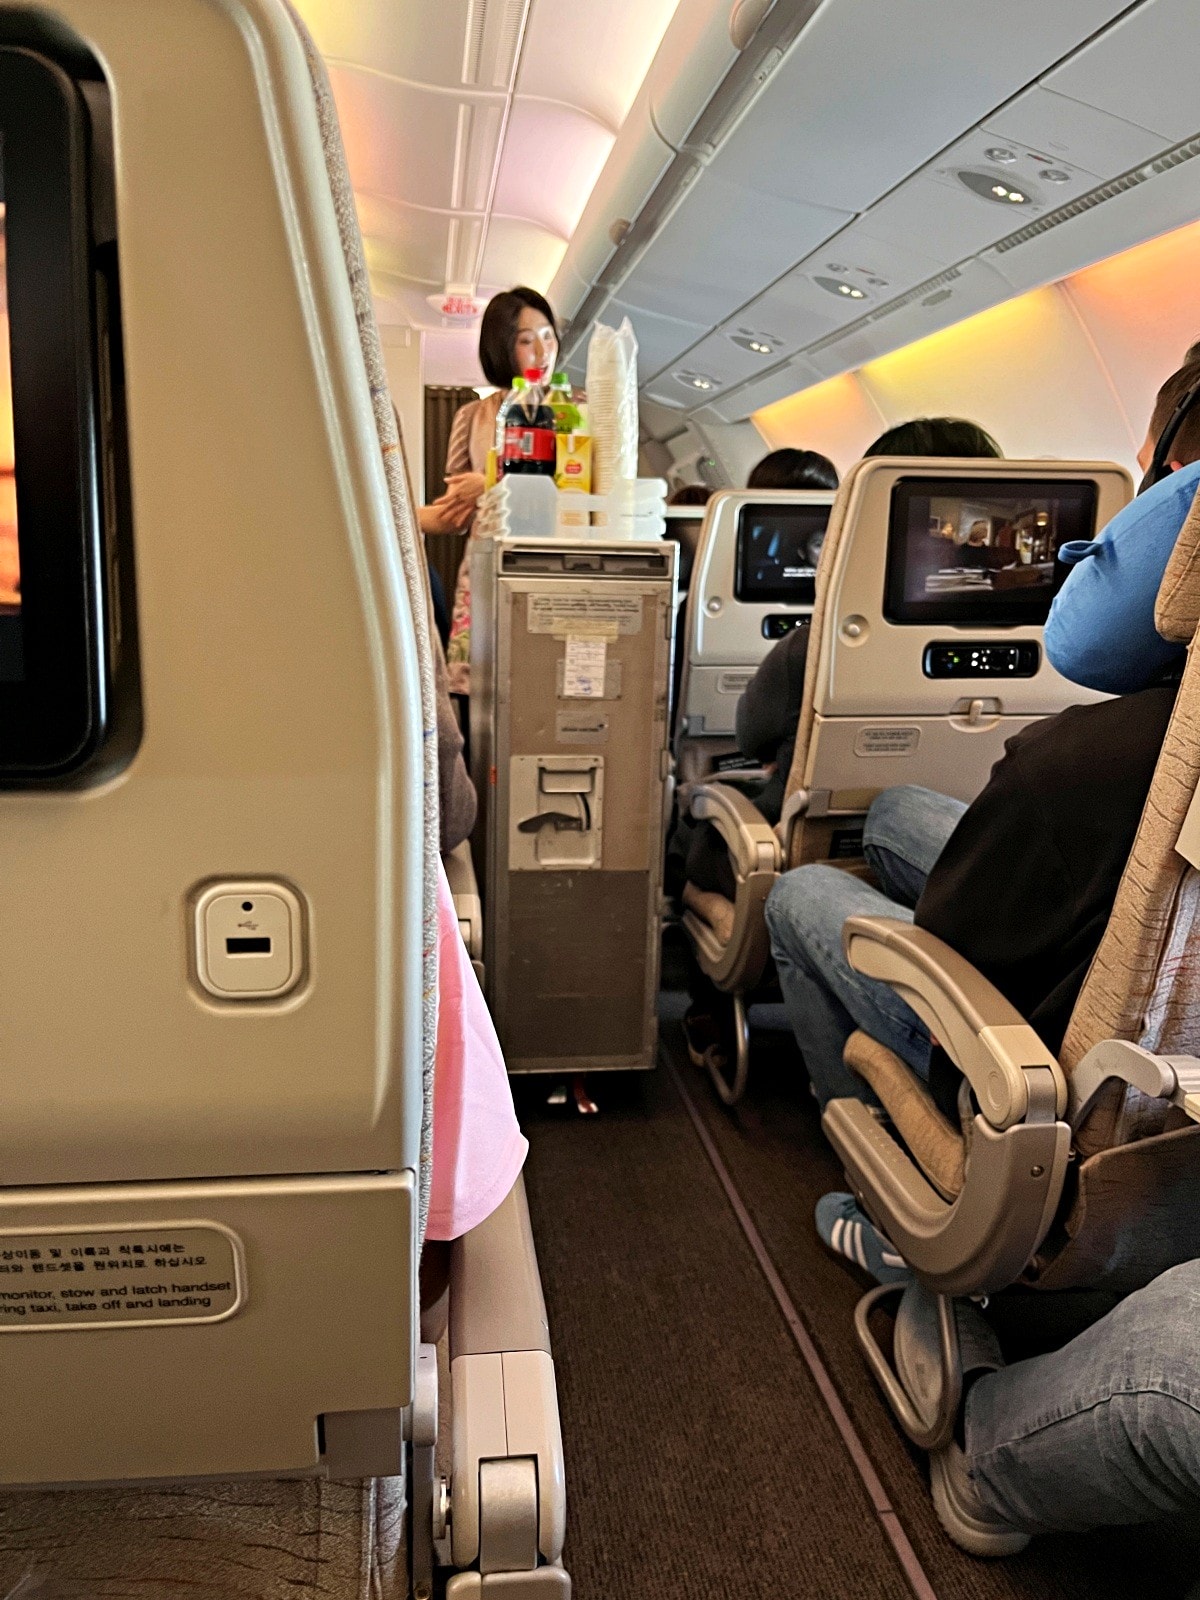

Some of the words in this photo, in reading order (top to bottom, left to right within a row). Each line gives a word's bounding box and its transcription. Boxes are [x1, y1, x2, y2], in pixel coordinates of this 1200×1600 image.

[94, 1258, 147, 1271] 원위치로
[154, 1256, 207, 1268] 하십시오
[60, 1288, 95, 1298] stow
[100, 1285, 128, 1296] and
[133, 1284, 167, 1295] latch
[172, 1281, 231, 1293] handset
[31, 1303, 61, 1313] taxi,
[65, 1301, 97, 1311] take
[102, 1299, 121, 1310] off
[126, 1298, 153, 1308] and
[158, 1296, 211, 1307] landing
